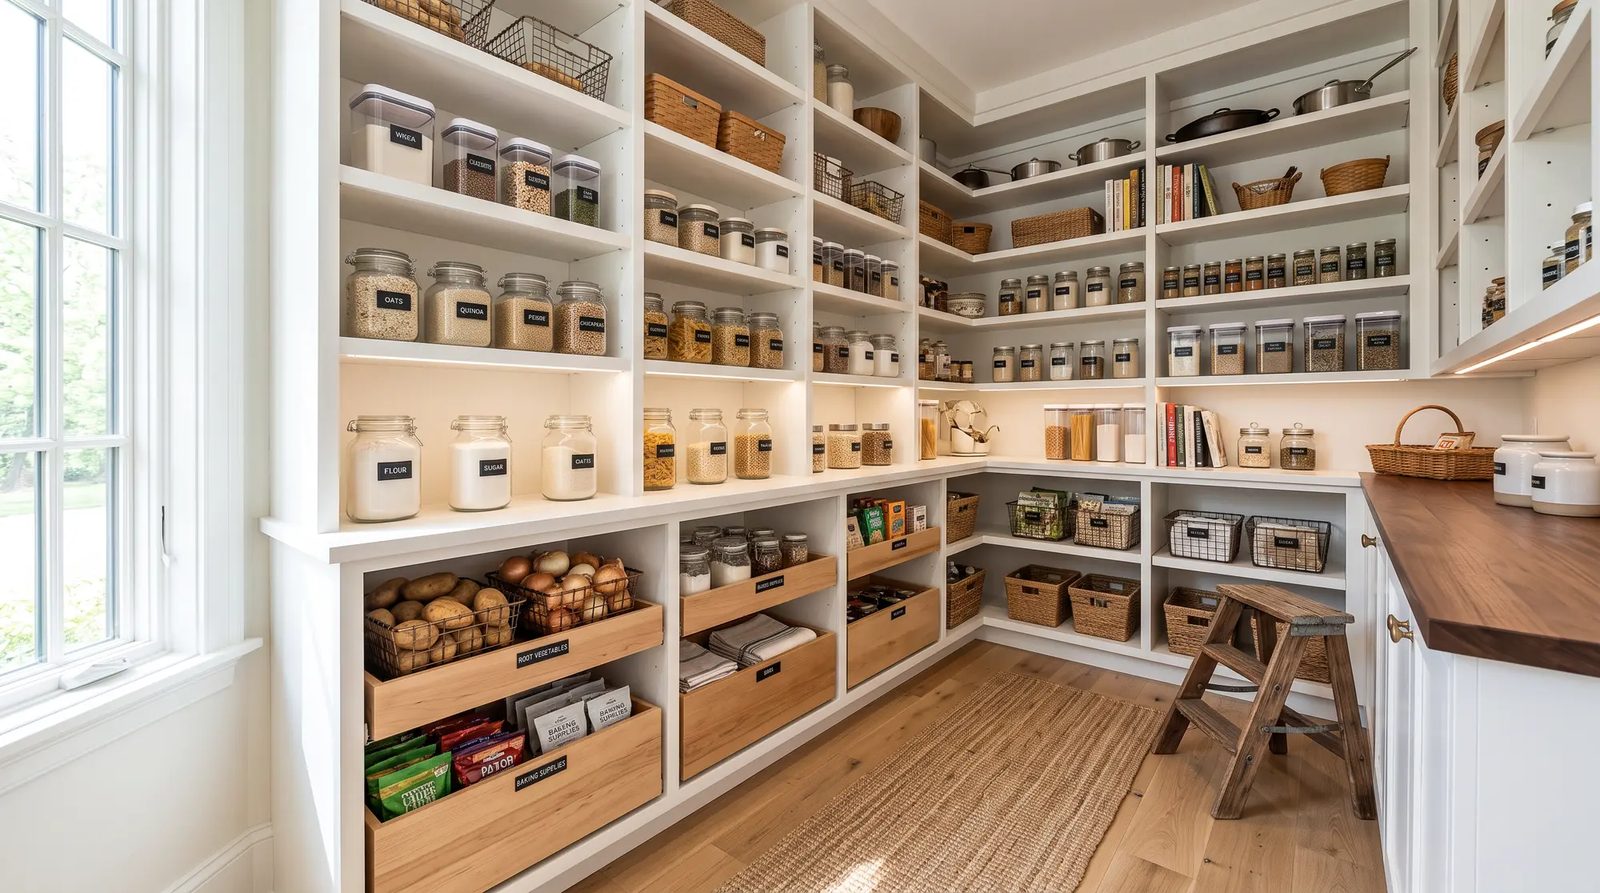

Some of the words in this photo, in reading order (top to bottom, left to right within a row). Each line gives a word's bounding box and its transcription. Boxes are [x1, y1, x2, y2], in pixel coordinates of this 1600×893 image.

[384, 296, 404, 305] OATS
[460, 306, 484, 316] QUINOA
[384, 467, 407, 475] FLOUR
[484, 464, 504, 472] SUGAR
[518, 653, 534, 664] ROOT
[534, 643, 568, 659] VEGETABLES
